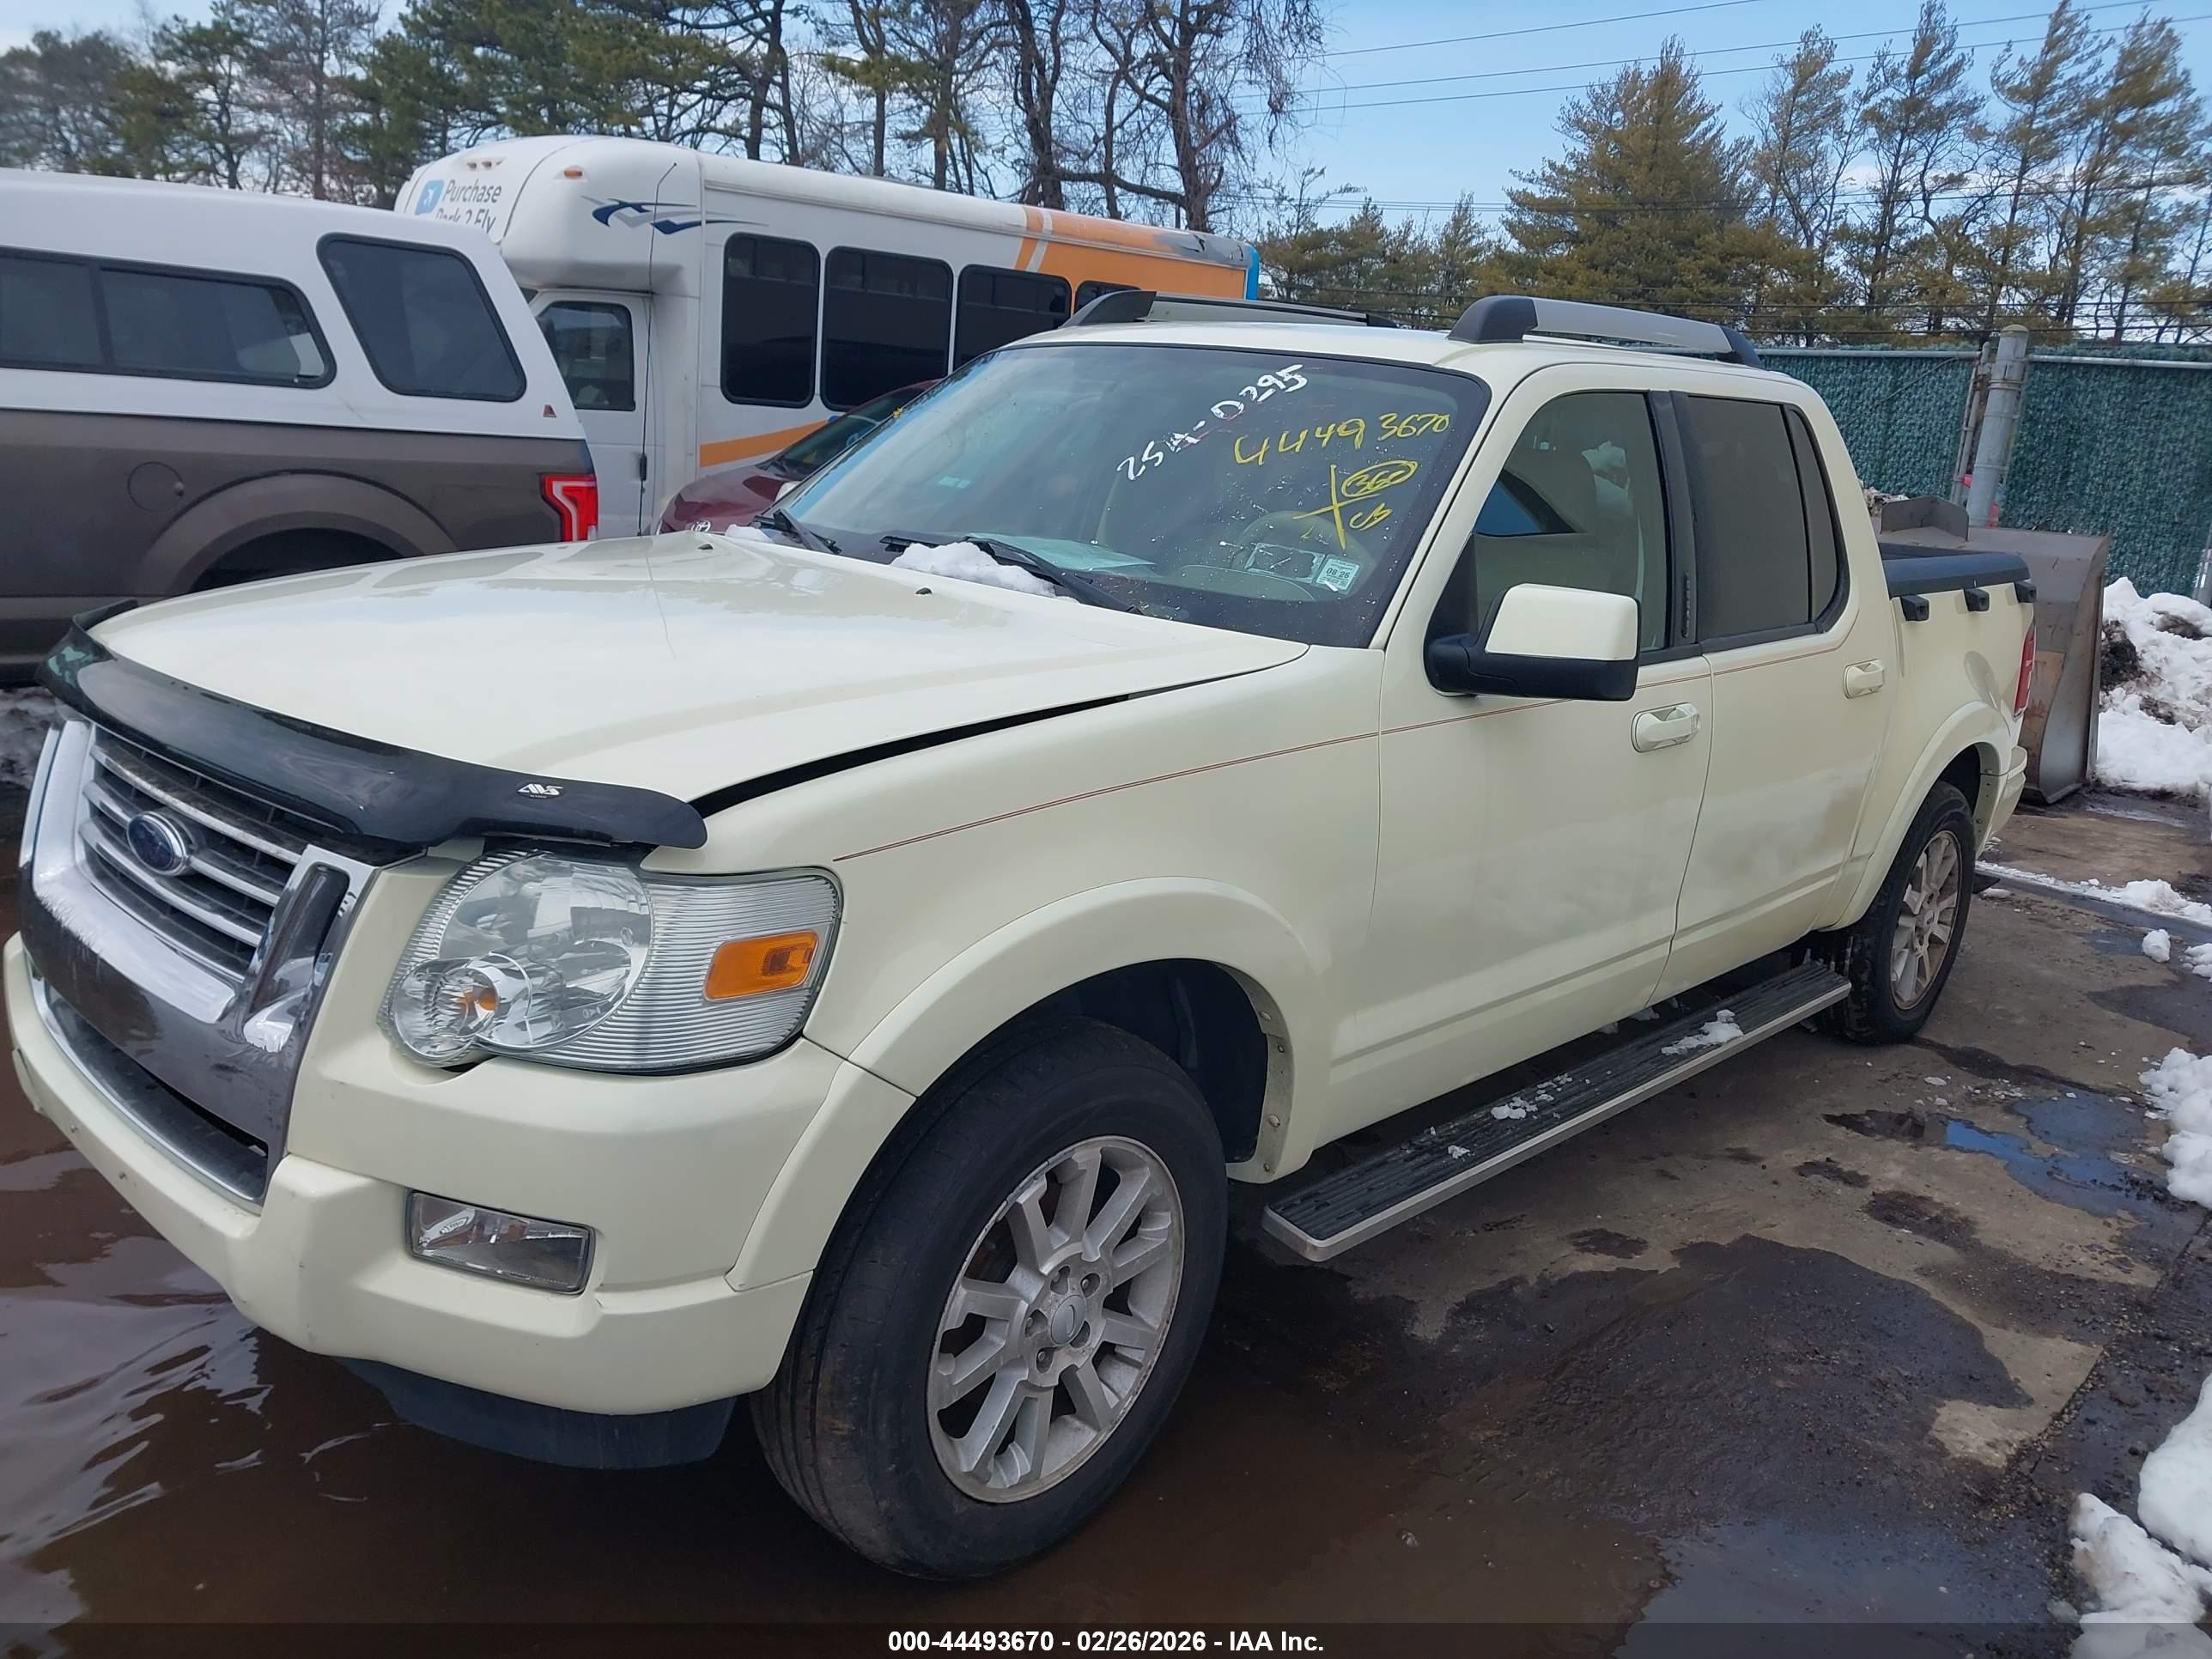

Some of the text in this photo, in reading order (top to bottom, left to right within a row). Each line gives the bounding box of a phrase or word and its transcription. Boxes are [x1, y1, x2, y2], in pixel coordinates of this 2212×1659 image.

[442, 179, 502, 204] Purchase
[474, 208, 496, 234] Fly
[1326, 567, 1338, 575] 08
